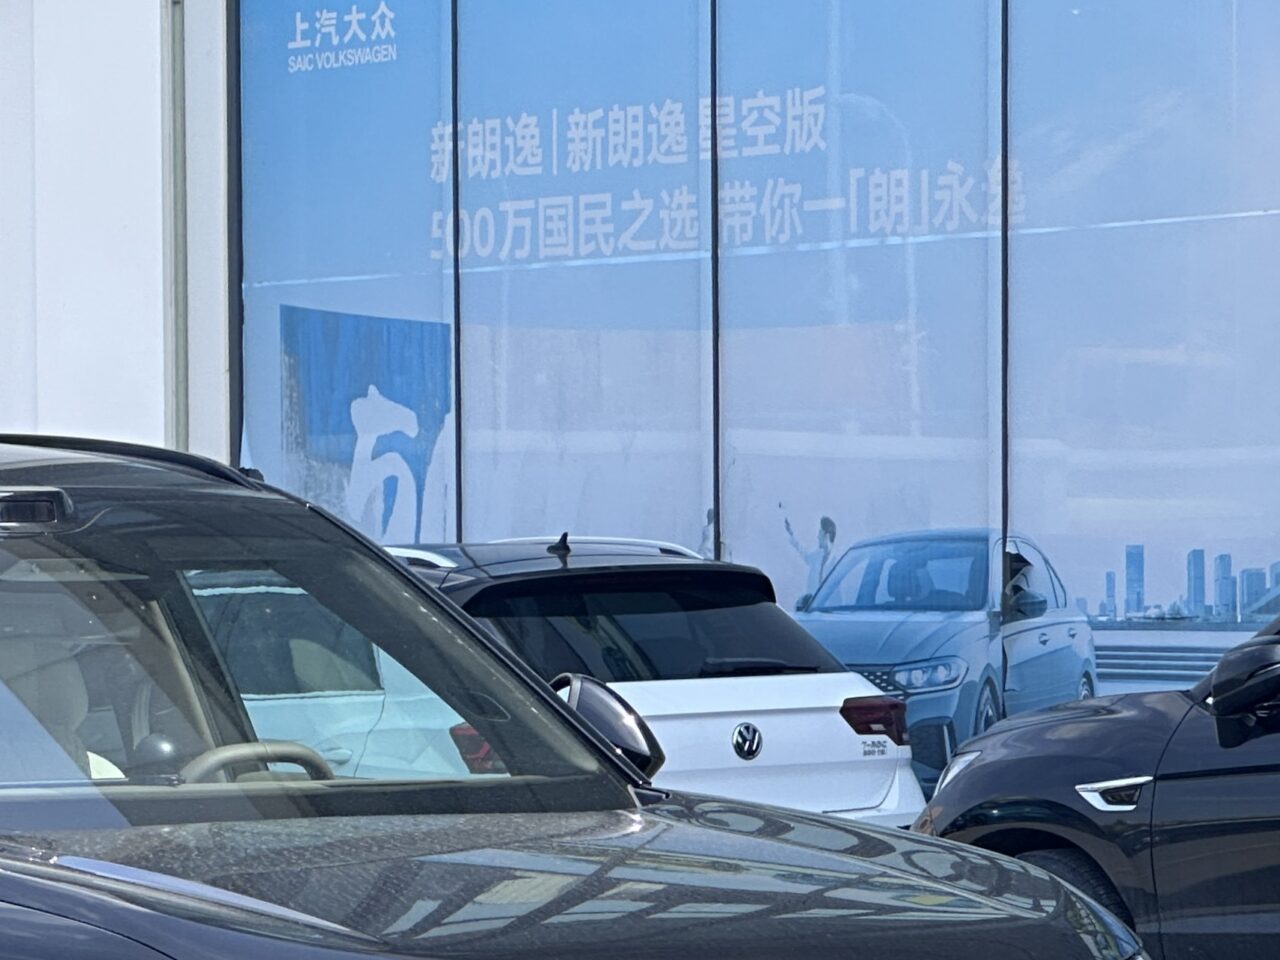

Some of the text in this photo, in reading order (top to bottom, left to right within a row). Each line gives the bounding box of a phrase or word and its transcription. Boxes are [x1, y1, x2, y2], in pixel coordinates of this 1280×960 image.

[287, 1, 396, 49] 上汽大众
[287, 44, 398, 73] SAIC VOLKSWAGEN
